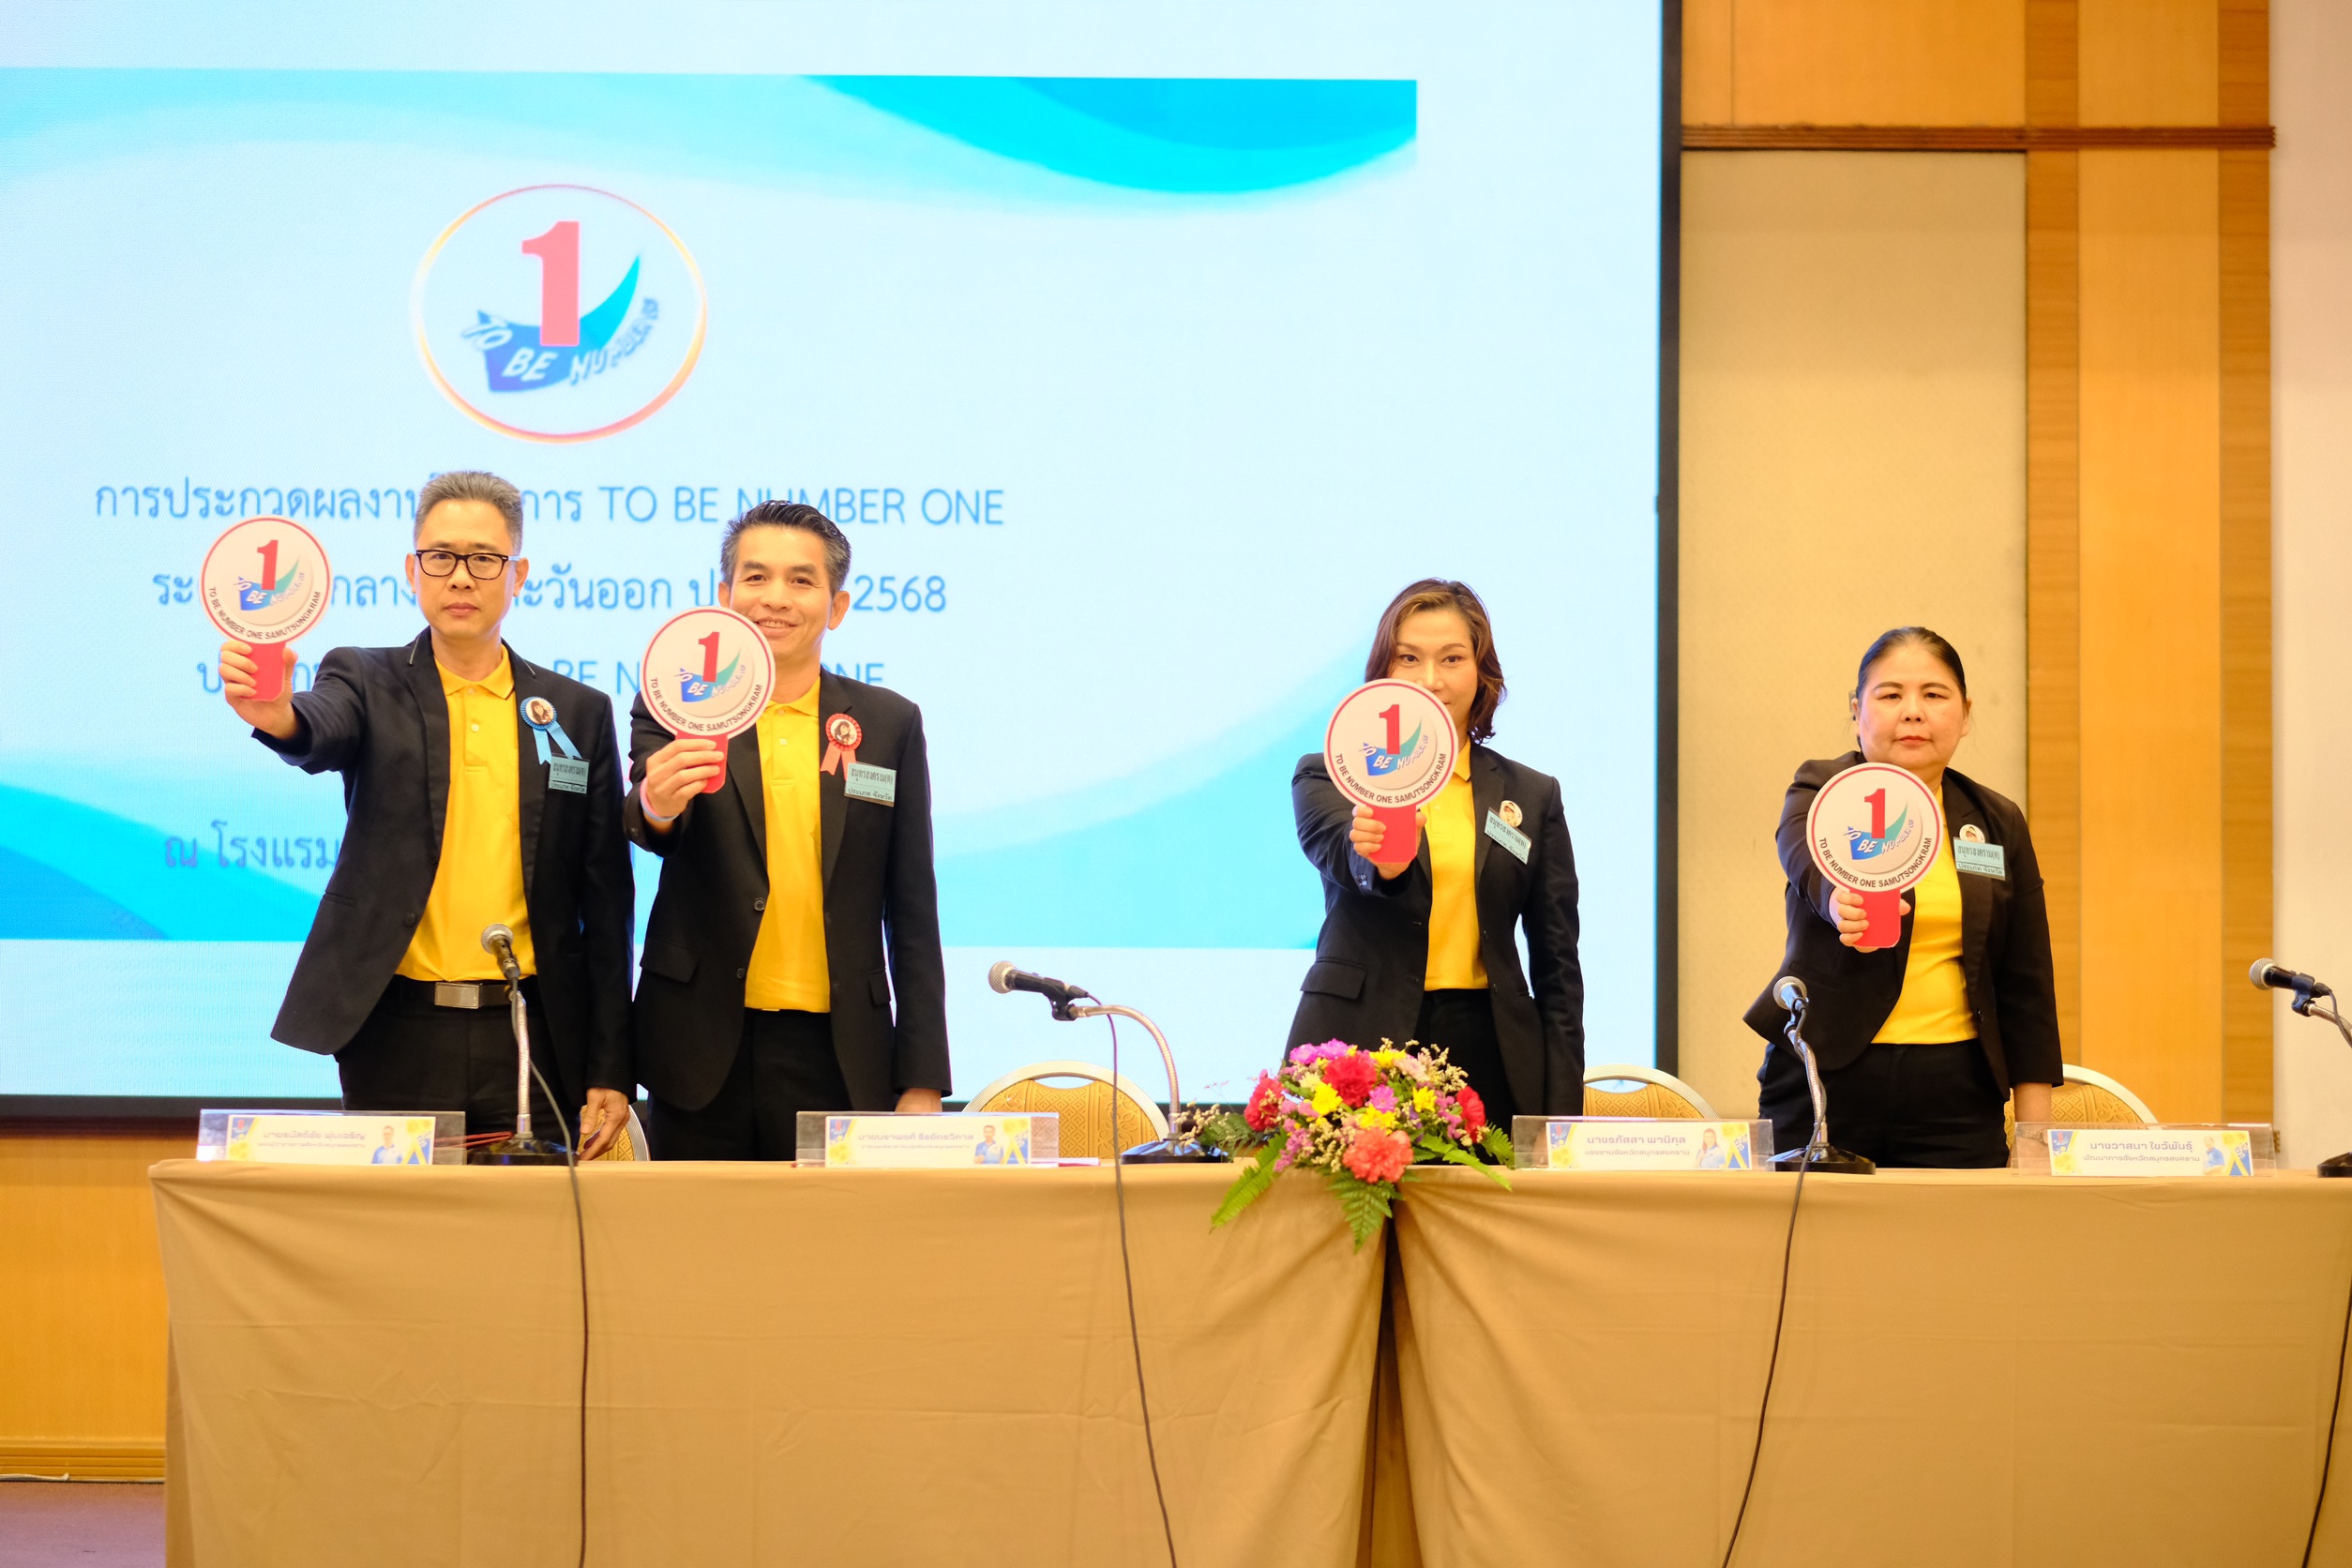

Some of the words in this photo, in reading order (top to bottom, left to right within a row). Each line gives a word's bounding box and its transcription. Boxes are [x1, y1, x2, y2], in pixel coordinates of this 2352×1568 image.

[521, 220, 580, 346] 1
[501, 346, 559, 382] BE
[598, 485, 658, 523] TO
[674, 487, 719, 522] BE
[921, 488, 1004, 526] ONE
[257, 539, 279, 591] 1
[852, 574, 947, 612] 2568
[698, 631, 720, 683] 1
[650, 676, 658, 688] TO
[653, 688, 663, 701] BE
[658, 701, 687, 727] NUMBER
[687, 720, 705, 731] ONE
[1379, 703, 1400, 755] 1
[1334, 753, 1344, 765] TO
[1339, 764, 1349, 777] BE
[1346, 776, 1376, 801] NUMBER
[1376, 794, 1394, 804] ONE
[1863, 788, 1886, 839] 1
[165, 835, 199, 868] ณ
[1818, 837, 1828, 849] TO
[1822, 849, 1833, 862] BE
[1857, 839, 1877, 854] BE
[1829, 860, 1859, 885] NUMBER
[1860, 878, 1877, 888] ONE
[2089, 1141, 2148, 1150] นางวาสนา
